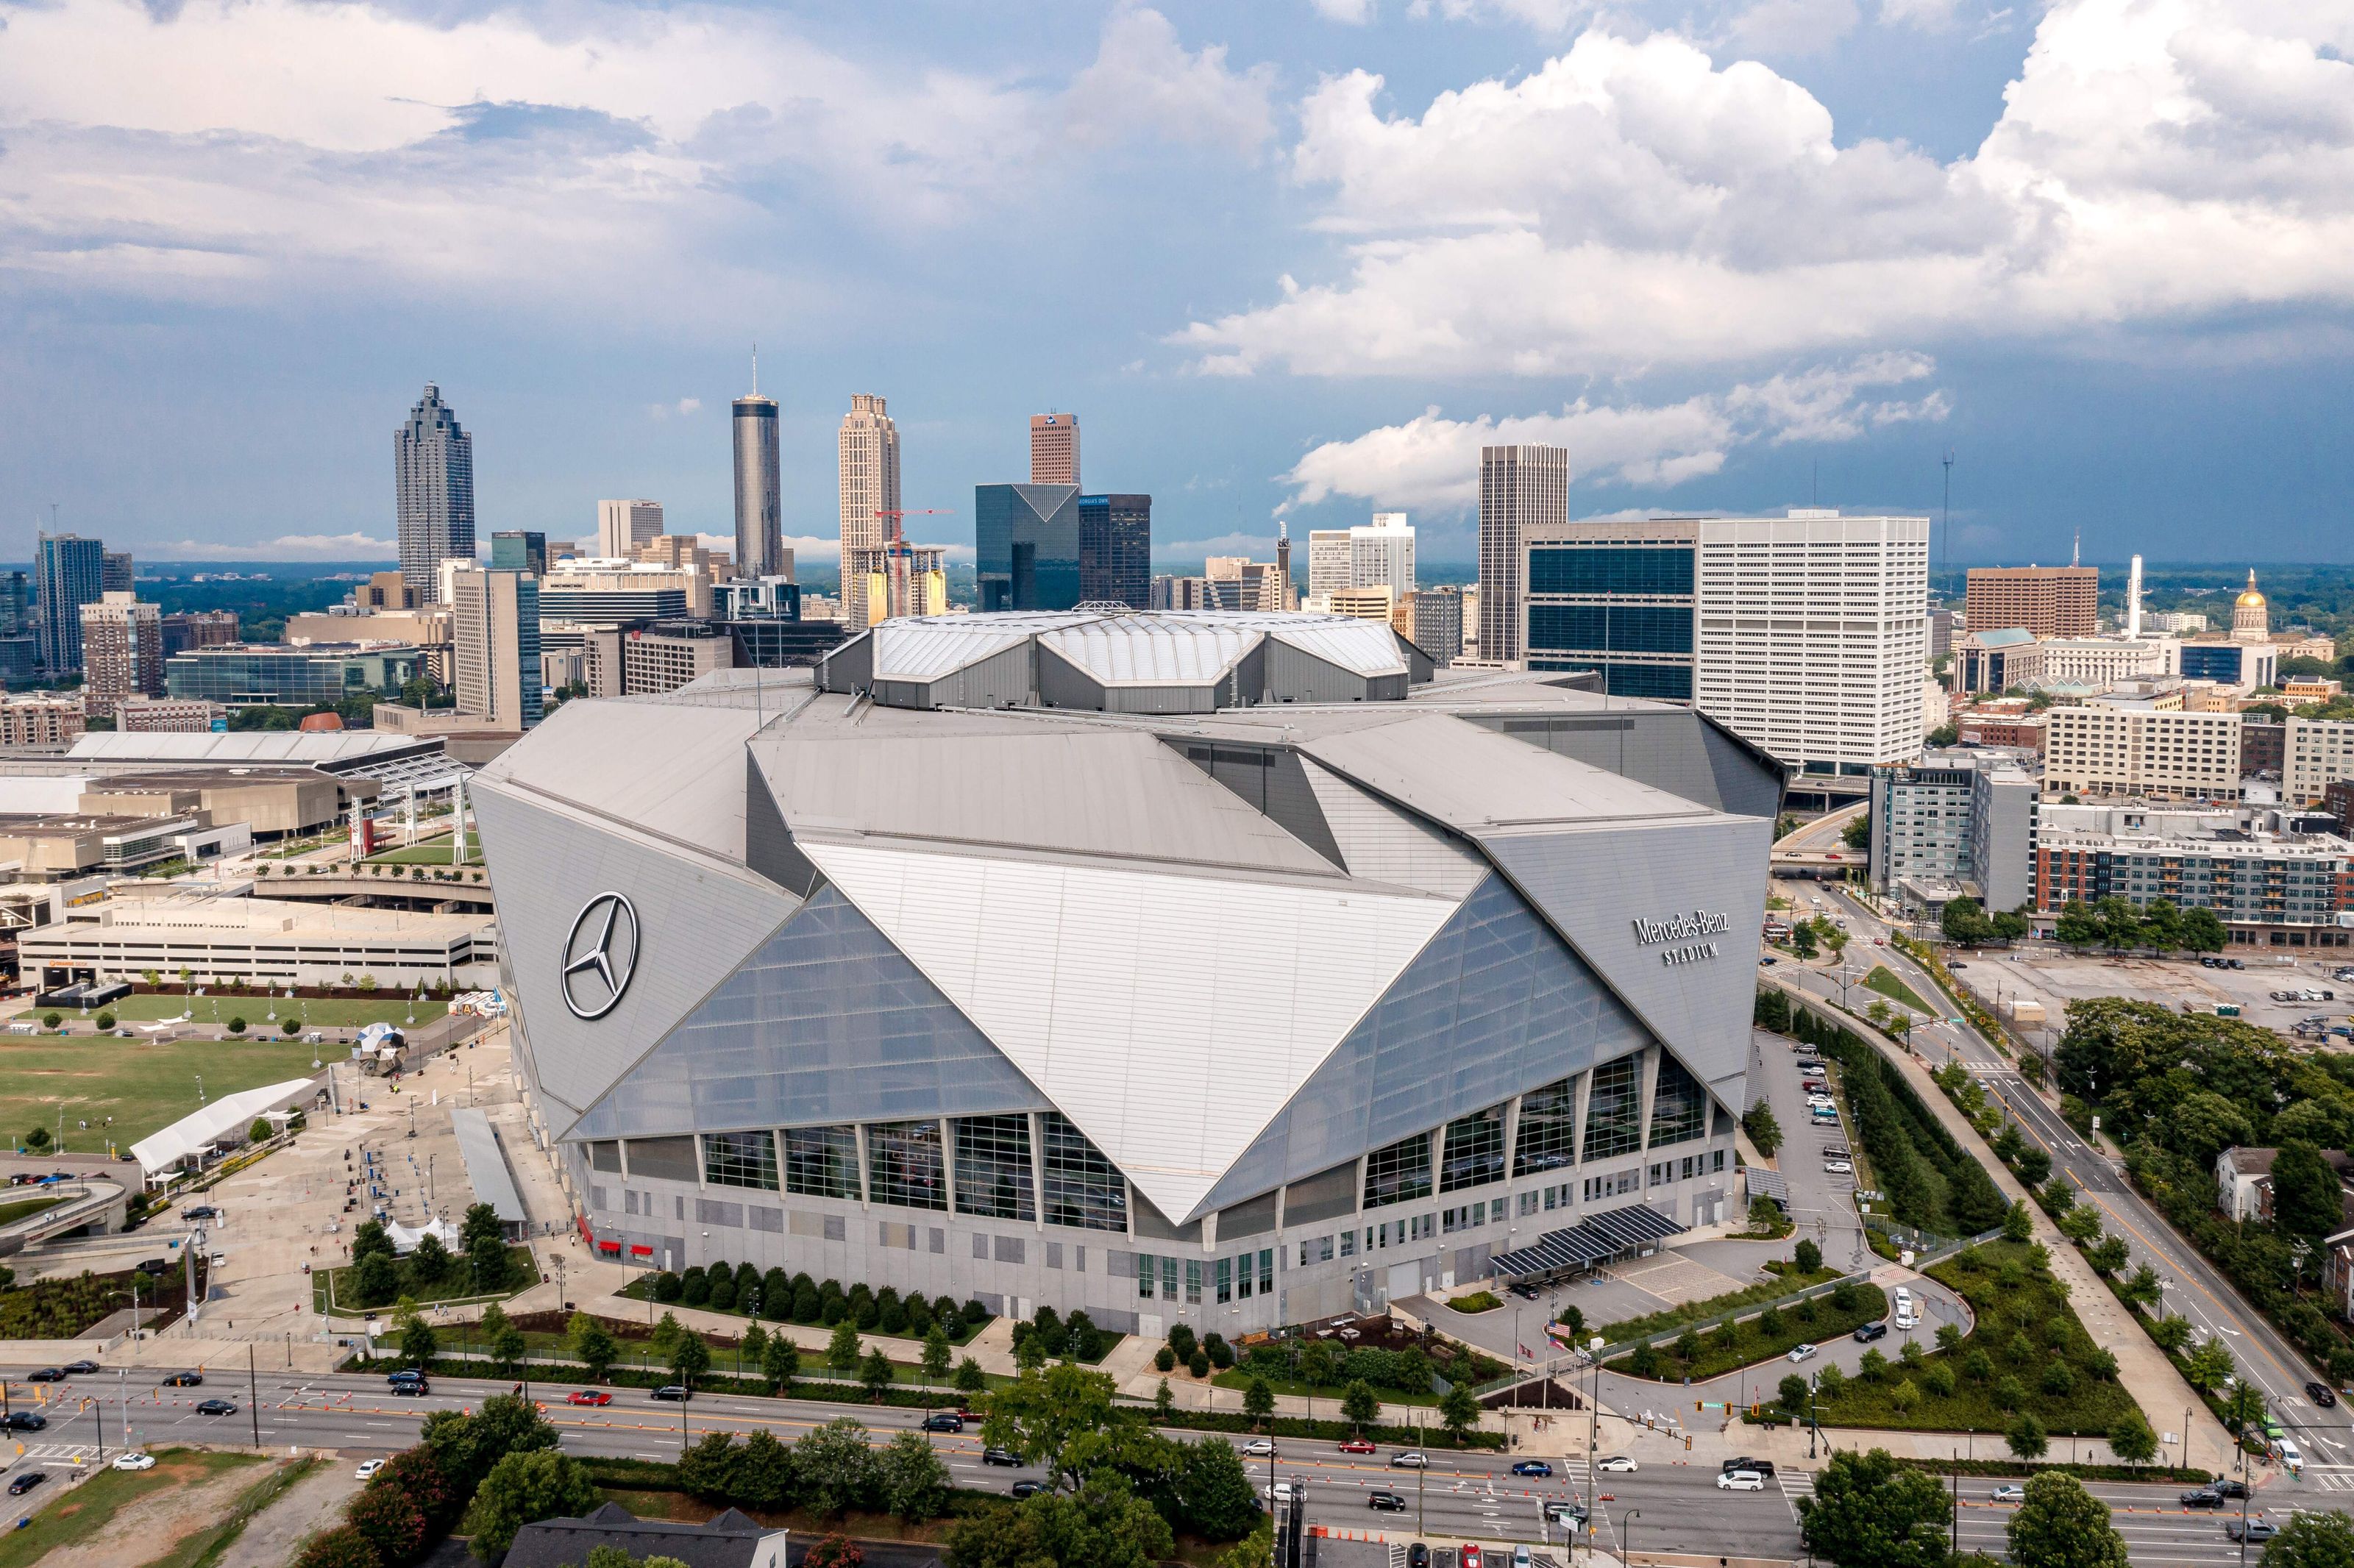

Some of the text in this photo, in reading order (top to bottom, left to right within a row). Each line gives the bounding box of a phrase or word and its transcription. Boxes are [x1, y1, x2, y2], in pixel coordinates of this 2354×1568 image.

[1634, 910, 1730, 965] Mercedes-Benz STADIUM
[464, 1005, 471, 1013] A
